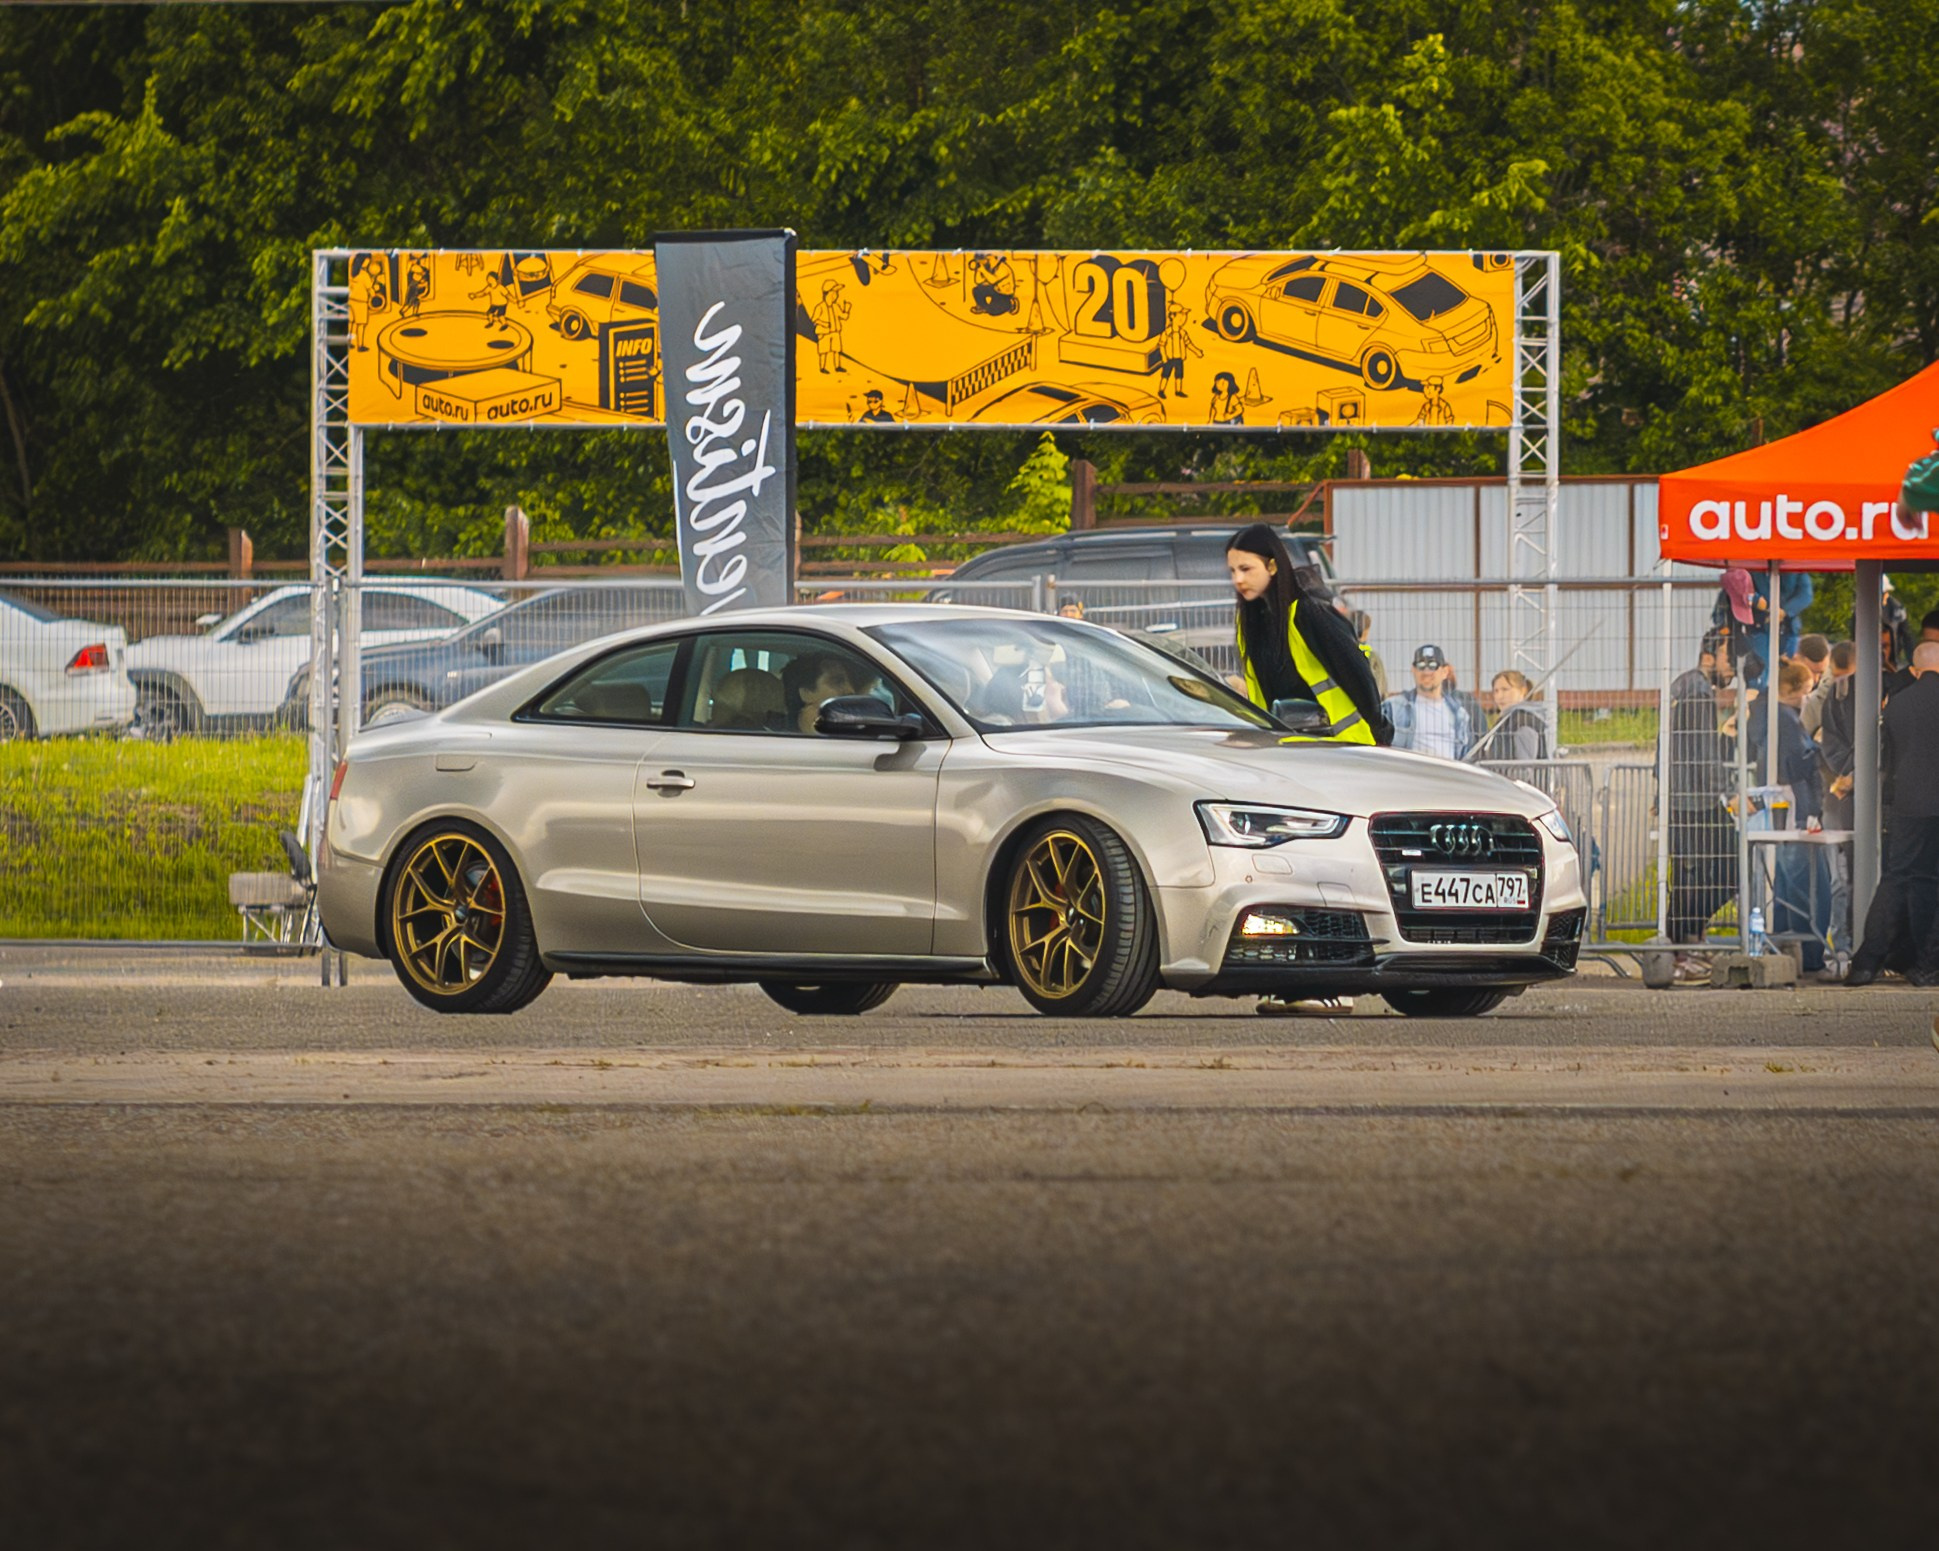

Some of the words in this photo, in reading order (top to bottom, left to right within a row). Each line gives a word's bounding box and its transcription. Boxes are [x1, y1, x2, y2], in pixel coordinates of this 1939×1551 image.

[1073, 260, 1150, 343] 20
[615, 337, 653, 357] INFO
[422, 394, 469, 421] auto.ru
[486, 391, 552, 420] auto.ru
[1689, 494, 1929, 541] auto.ru
[1497, 877, 1523, 897] 797
